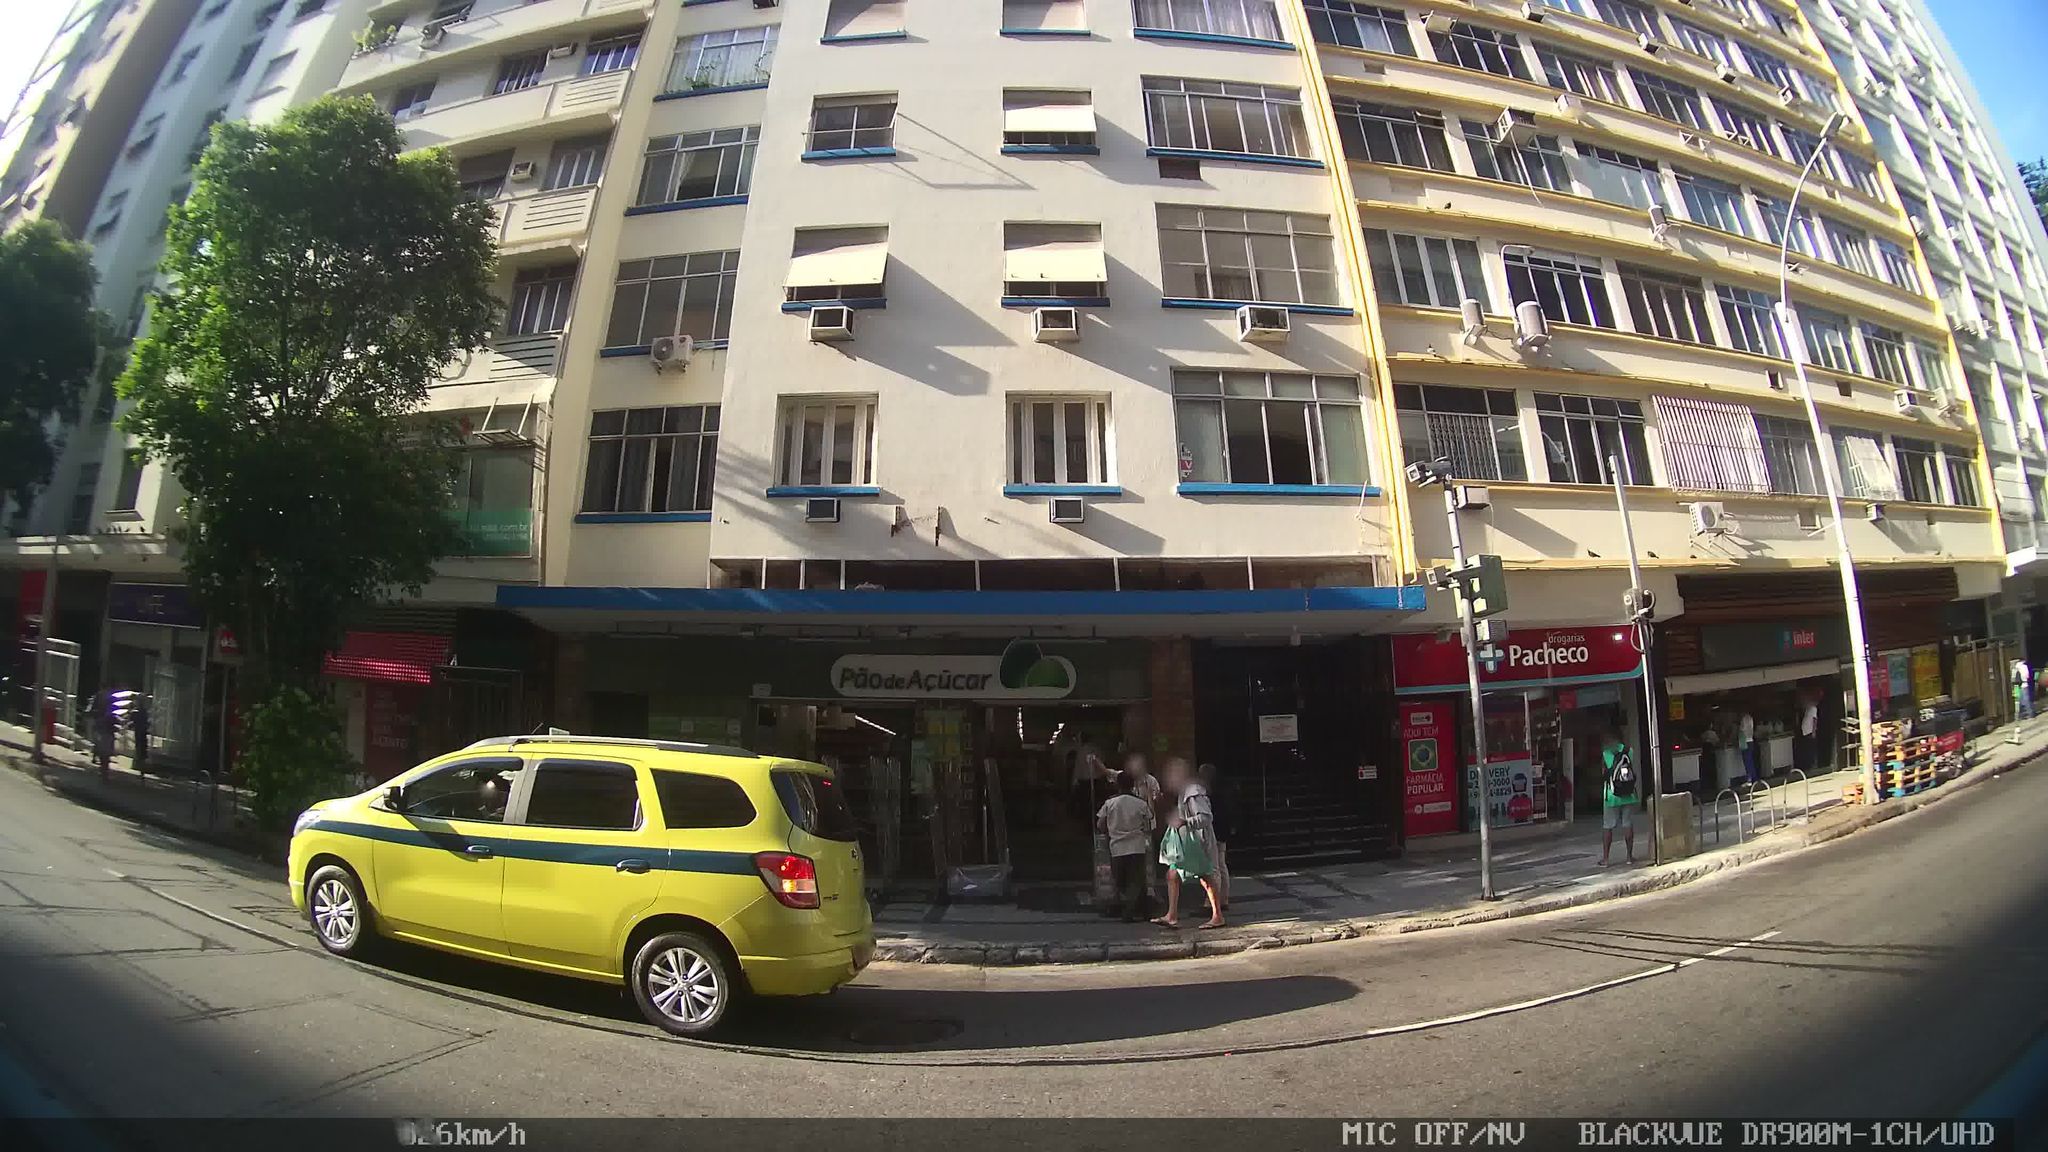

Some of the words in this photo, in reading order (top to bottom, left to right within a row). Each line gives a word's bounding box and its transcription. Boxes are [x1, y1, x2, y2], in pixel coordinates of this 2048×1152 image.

[1548, 633, 1585, 645] drogarias
[1509, 642, 1589, 667] Pacheco
[839, 667, 881, 690] Pão
[884, 673, 905, 690] de
[906, 669, 993, 693] Açúcar
[1407, 783, 1445, 795] POPULAR
